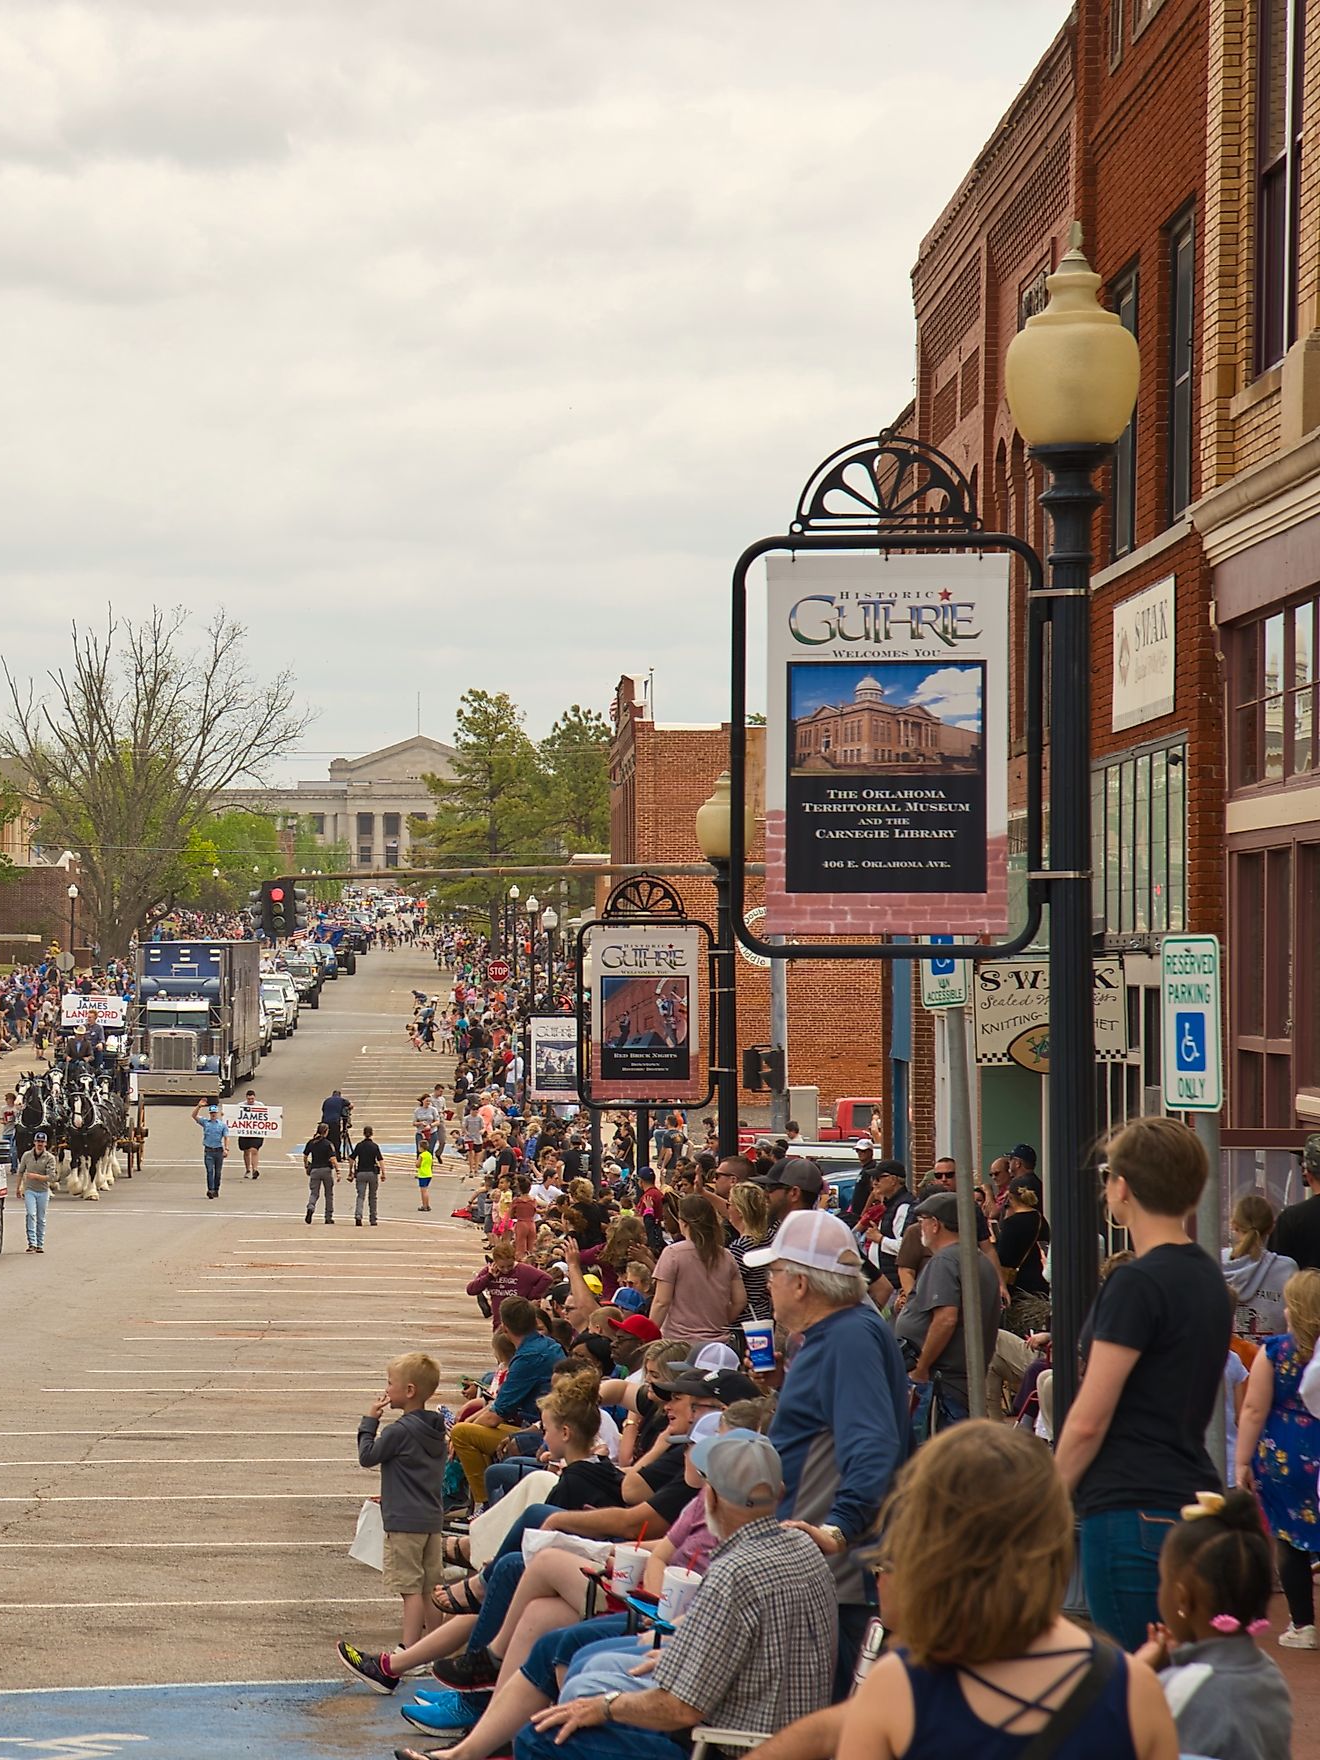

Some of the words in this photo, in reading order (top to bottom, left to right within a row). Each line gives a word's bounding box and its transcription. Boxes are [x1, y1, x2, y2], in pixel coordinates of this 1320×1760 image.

[840, 591, 934, 599] HISTORIC
[788, 594, 983, 647] GUTHRIE
[832, 650, 908, 658] WELCOMES
[914, 649, 941, 658] YOU
[827, 789, 858, 799] THE
[862, 789, 946, 799] OKLAHOMA
[802, 802, 901, 813] TERRITORIAL
[905, 802, 970, 812] MUSEUM
[815, 829, 889, 839] CARNEGIE
[894, 829, 957, 839] LIBRARY
[822, 860, 844, 868] 406
[847, 860, 858, 868] E.
[862, 860, 923, 868] OKLAHOMA
[925, 860, 951, 868] AVE.
[601, 945, 688, 969] GUTHRIE
[1166, 954, 1214, 975] RESERVED
[490, 966, 508, 975] STOP
[937, 978, 950, 988] VAN
[927, 988, 963, 1001] ACCESSIBLE
[1168, 984, 1211, 1004] PARKING
[76, 1000, 108, 1010] JAMES
[981, 994, 1033, 1009] Sealed
[981, 1011, 1042, 1034] KNITTING
[237, 1110, 269, 1121] JAMES
[226, 1120, 279, 1130] LANKFORD
